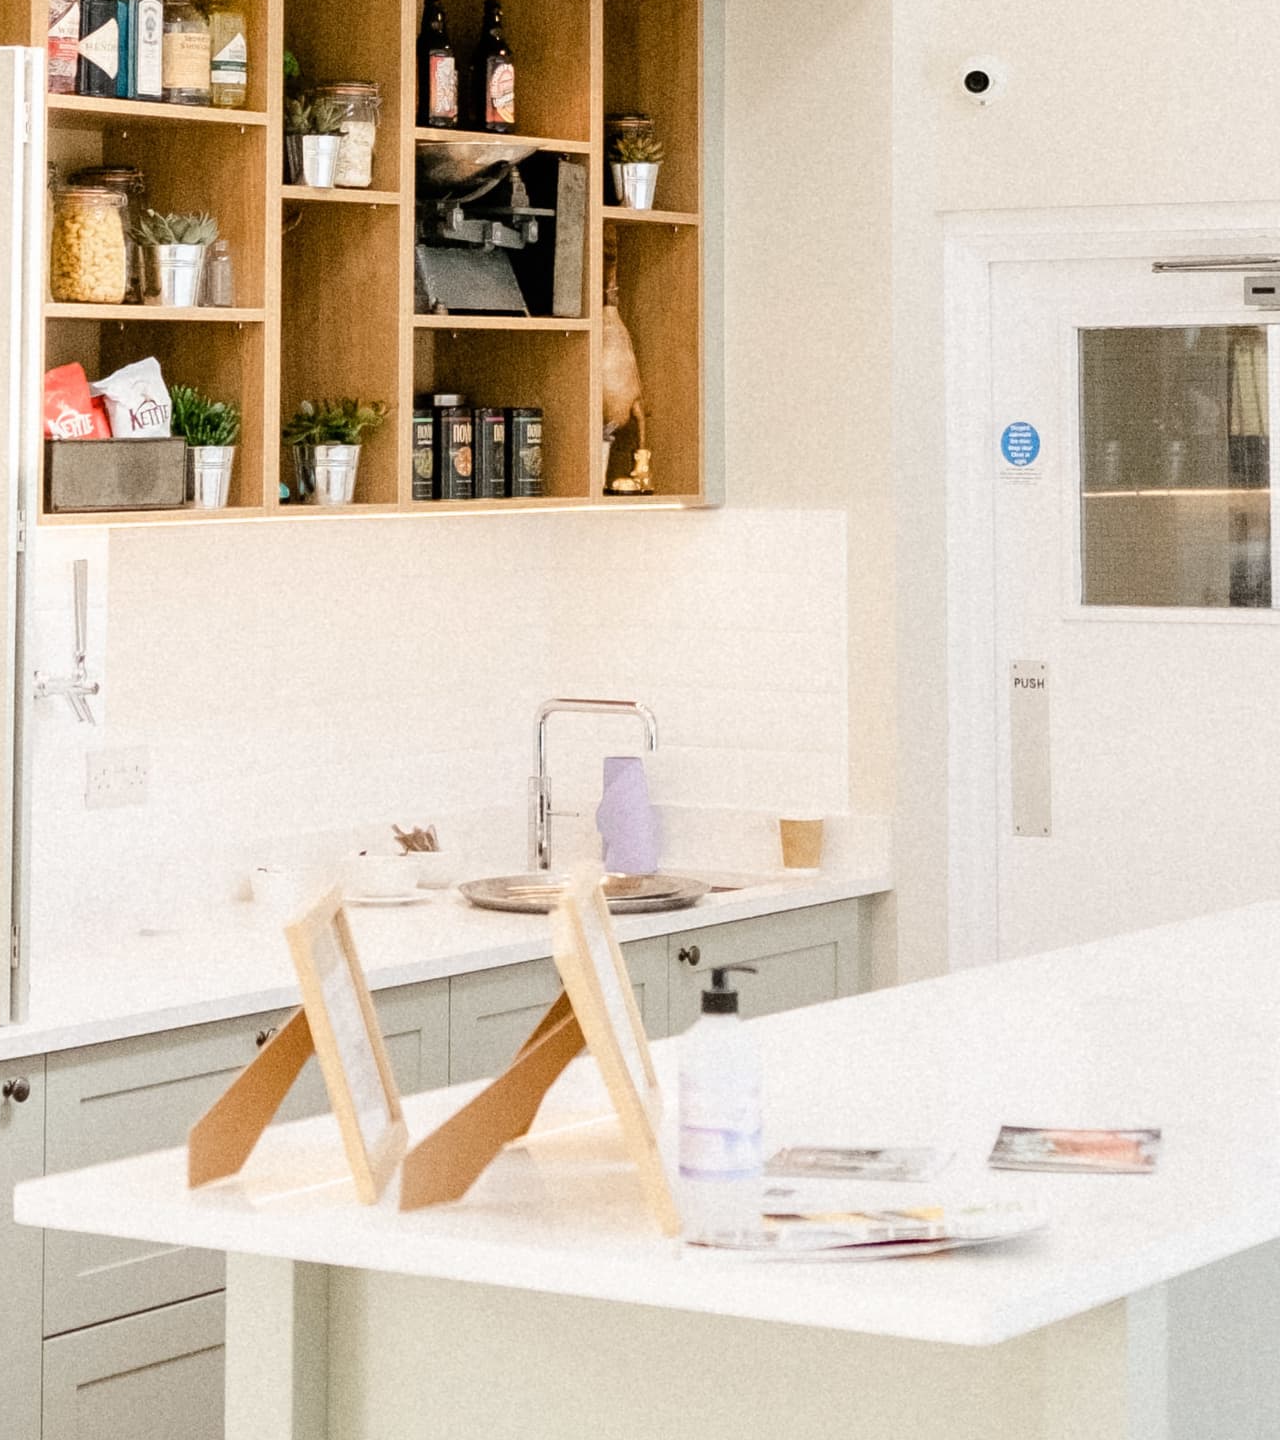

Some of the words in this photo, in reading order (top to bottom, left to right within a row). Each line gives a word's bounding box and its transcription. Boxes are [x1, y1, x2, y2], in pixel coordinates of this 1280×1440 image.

[48, 411, 94, 440] KETTLE
[128, 403, 169, 432] KETTLE
[1014, 677, 1045, 689] PUSH
